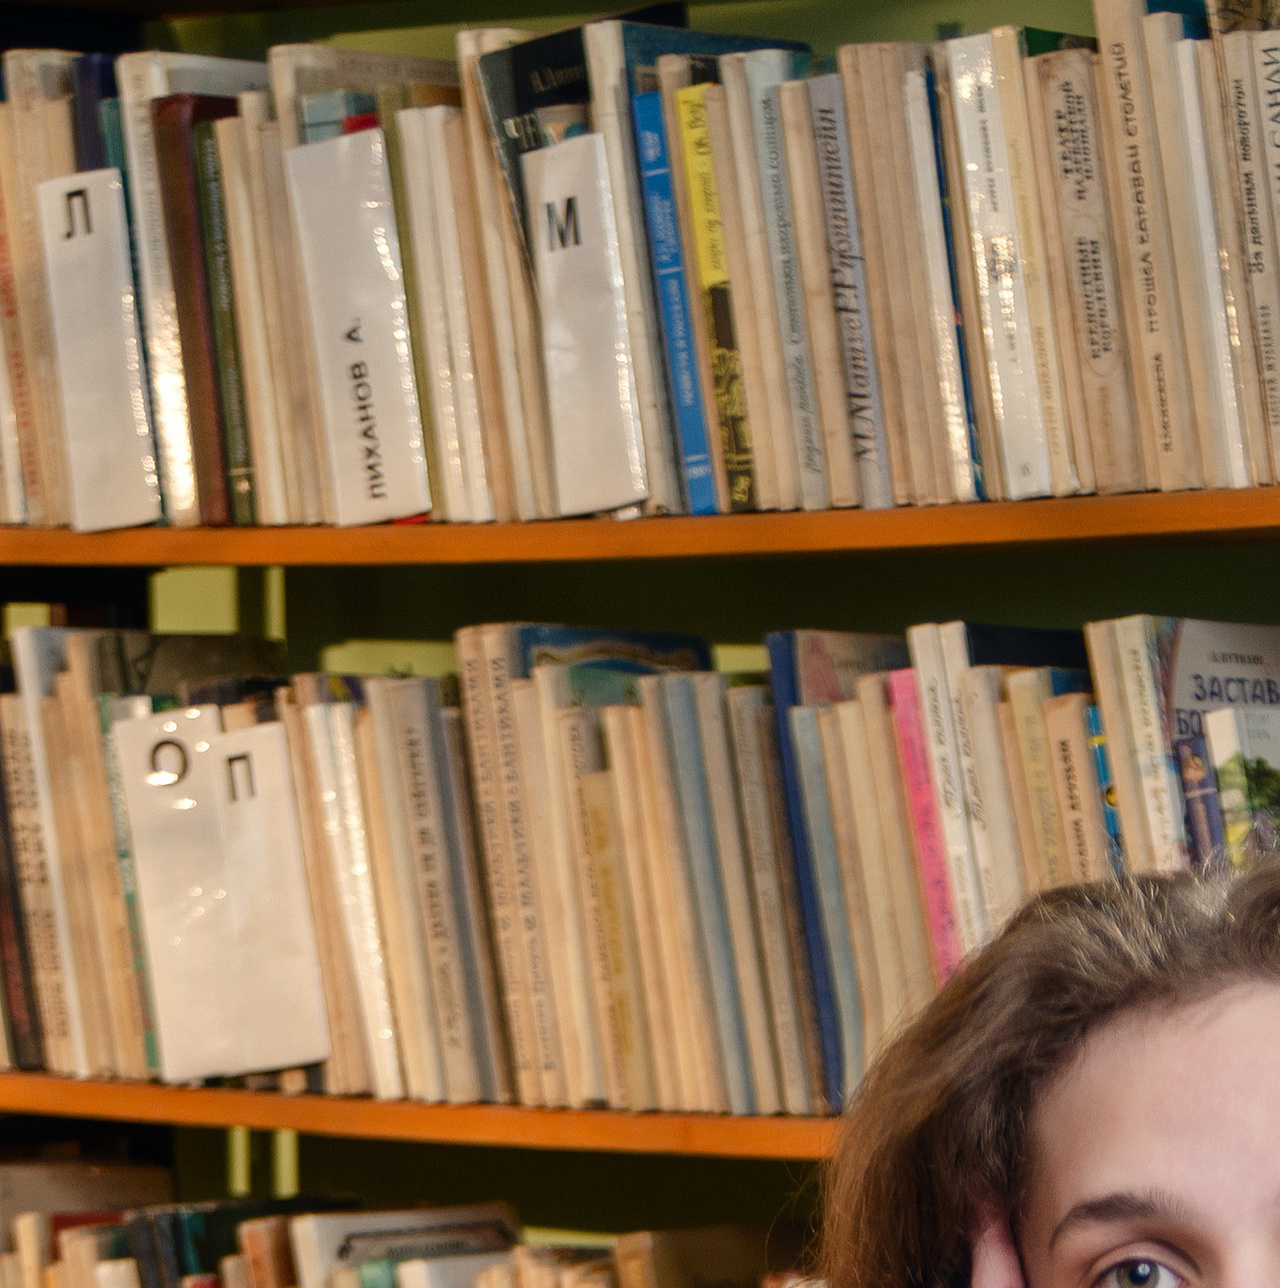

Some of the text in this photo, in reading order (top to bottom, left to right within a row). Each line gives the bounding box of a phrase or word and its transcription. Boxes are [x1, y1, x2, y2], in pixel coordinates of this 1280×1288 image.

[62, 189, 90, 239] Л
[539, 196, 582, 251] М
[342, 317, 389, 499] ЛИХАНОВ А.
[226, 752, 255, 802] П
